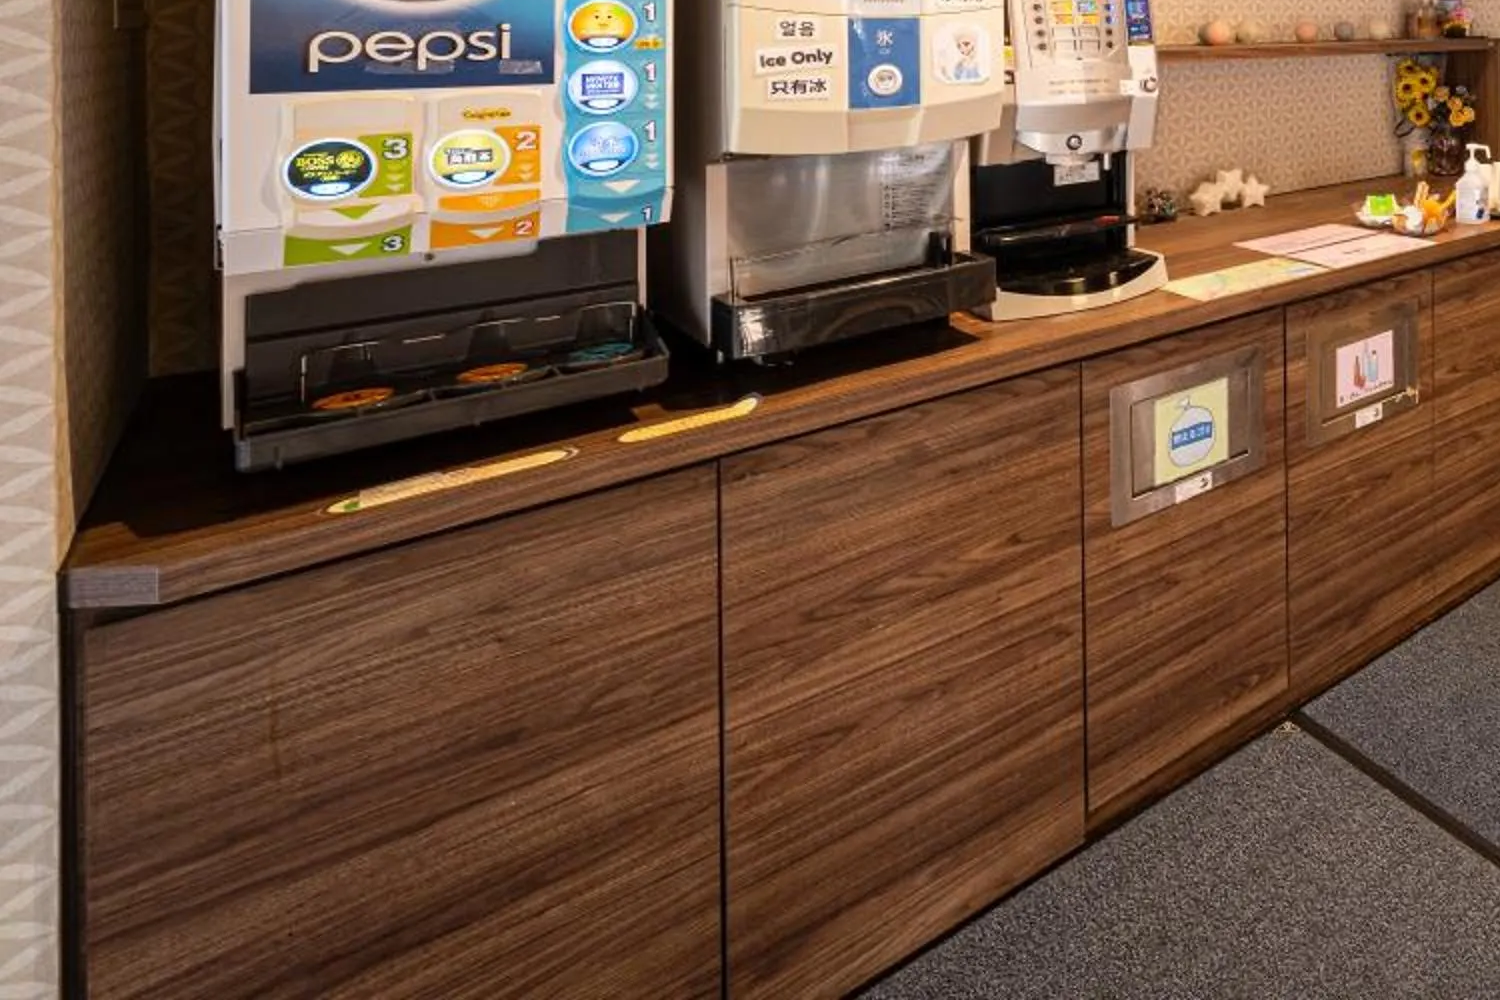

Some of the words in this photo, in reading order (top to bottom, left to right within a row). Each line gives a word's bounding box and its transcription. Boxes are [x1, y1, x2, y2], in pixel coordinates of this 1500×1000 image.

[644, 3, 657, 22] 1
[780, 20, 816, 37] 얼음
[307, 23, 512, 74] pepsi
[876, 30, 894, 48] 氷
[760, 54, 787, 68] Ice
[791, 48, 834, 65] Only
[644, 62, 657, 82] 1
[770, 77, 828, 95] 只有冰
[644, 120, 656, 141] 1
[383, 137, 409, 160] 3
[515, 131, 538, 151] 2
[642, 206, 653, 222] 1
[513, 216, 535, 236] 2
[381, 234, 405, 253] 3
